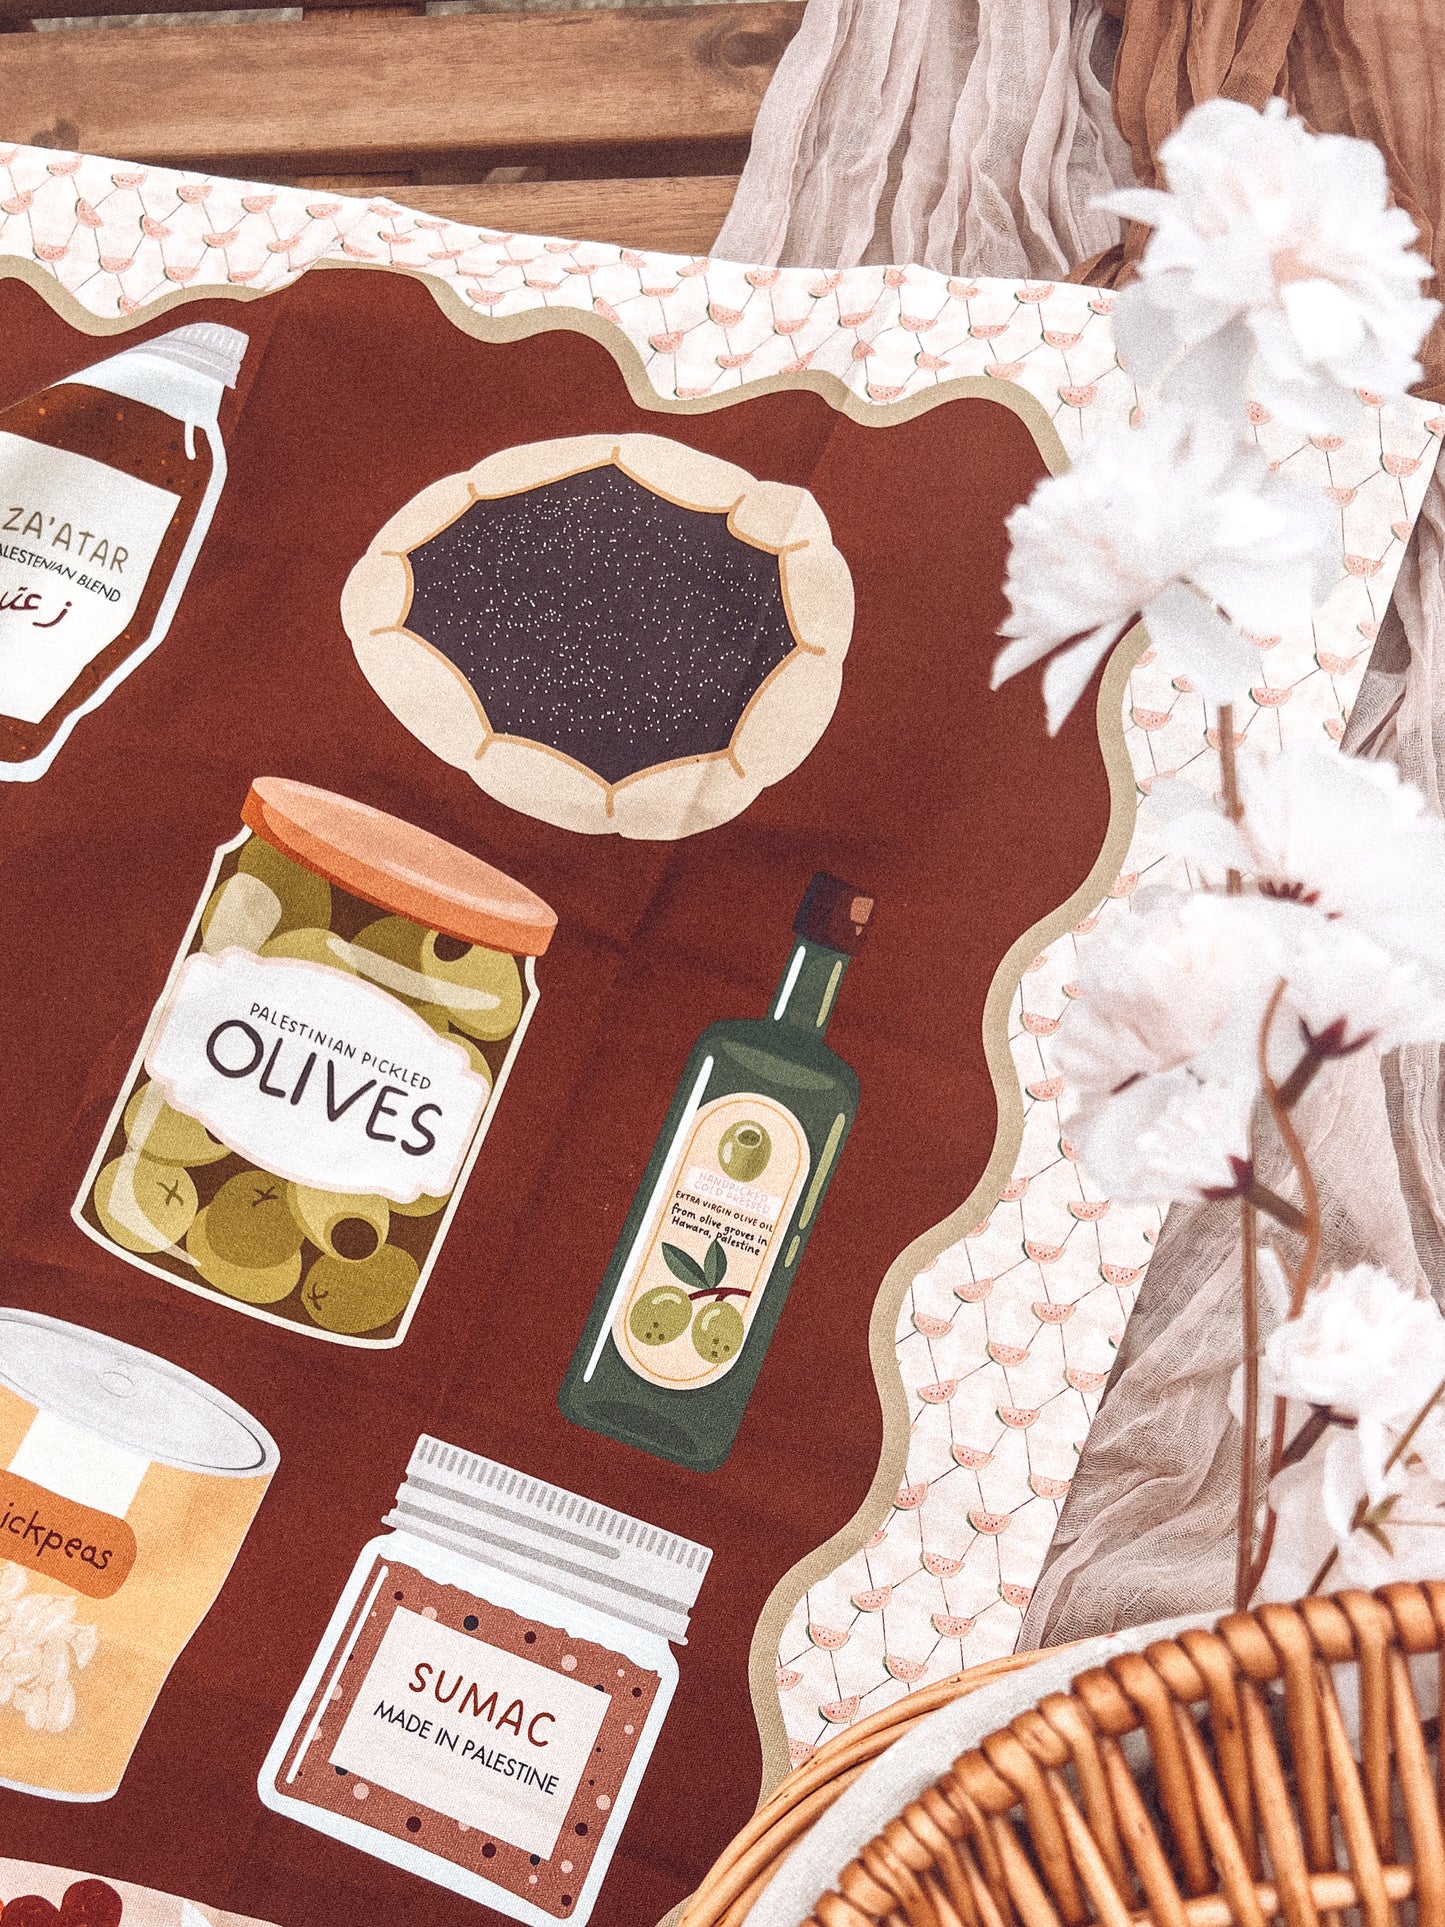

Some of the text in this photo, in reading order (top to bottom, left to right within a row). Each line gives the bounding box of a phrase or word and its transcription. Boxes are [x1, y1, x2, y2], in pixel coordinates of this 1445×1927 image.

[2, 508, 129, 573] ZA'ATAR
[77, 574, 121, 602] BLEND
[249, 1003, 431, 1090] PALESTINIAN PICKLED
[206, 1019, 443, 1156] OLIVES
[671, 1202, 768, 1247] from olive groves in
[675, 1190, 773, 1232] EXTRA VIRGIN OLIVE OIL
[715, 1232, 760, 1256] Palestine
[408, 1662, 557, 1747] SUMAC
[373, 1700, 560, 1796] MADE IN PALESTINE
